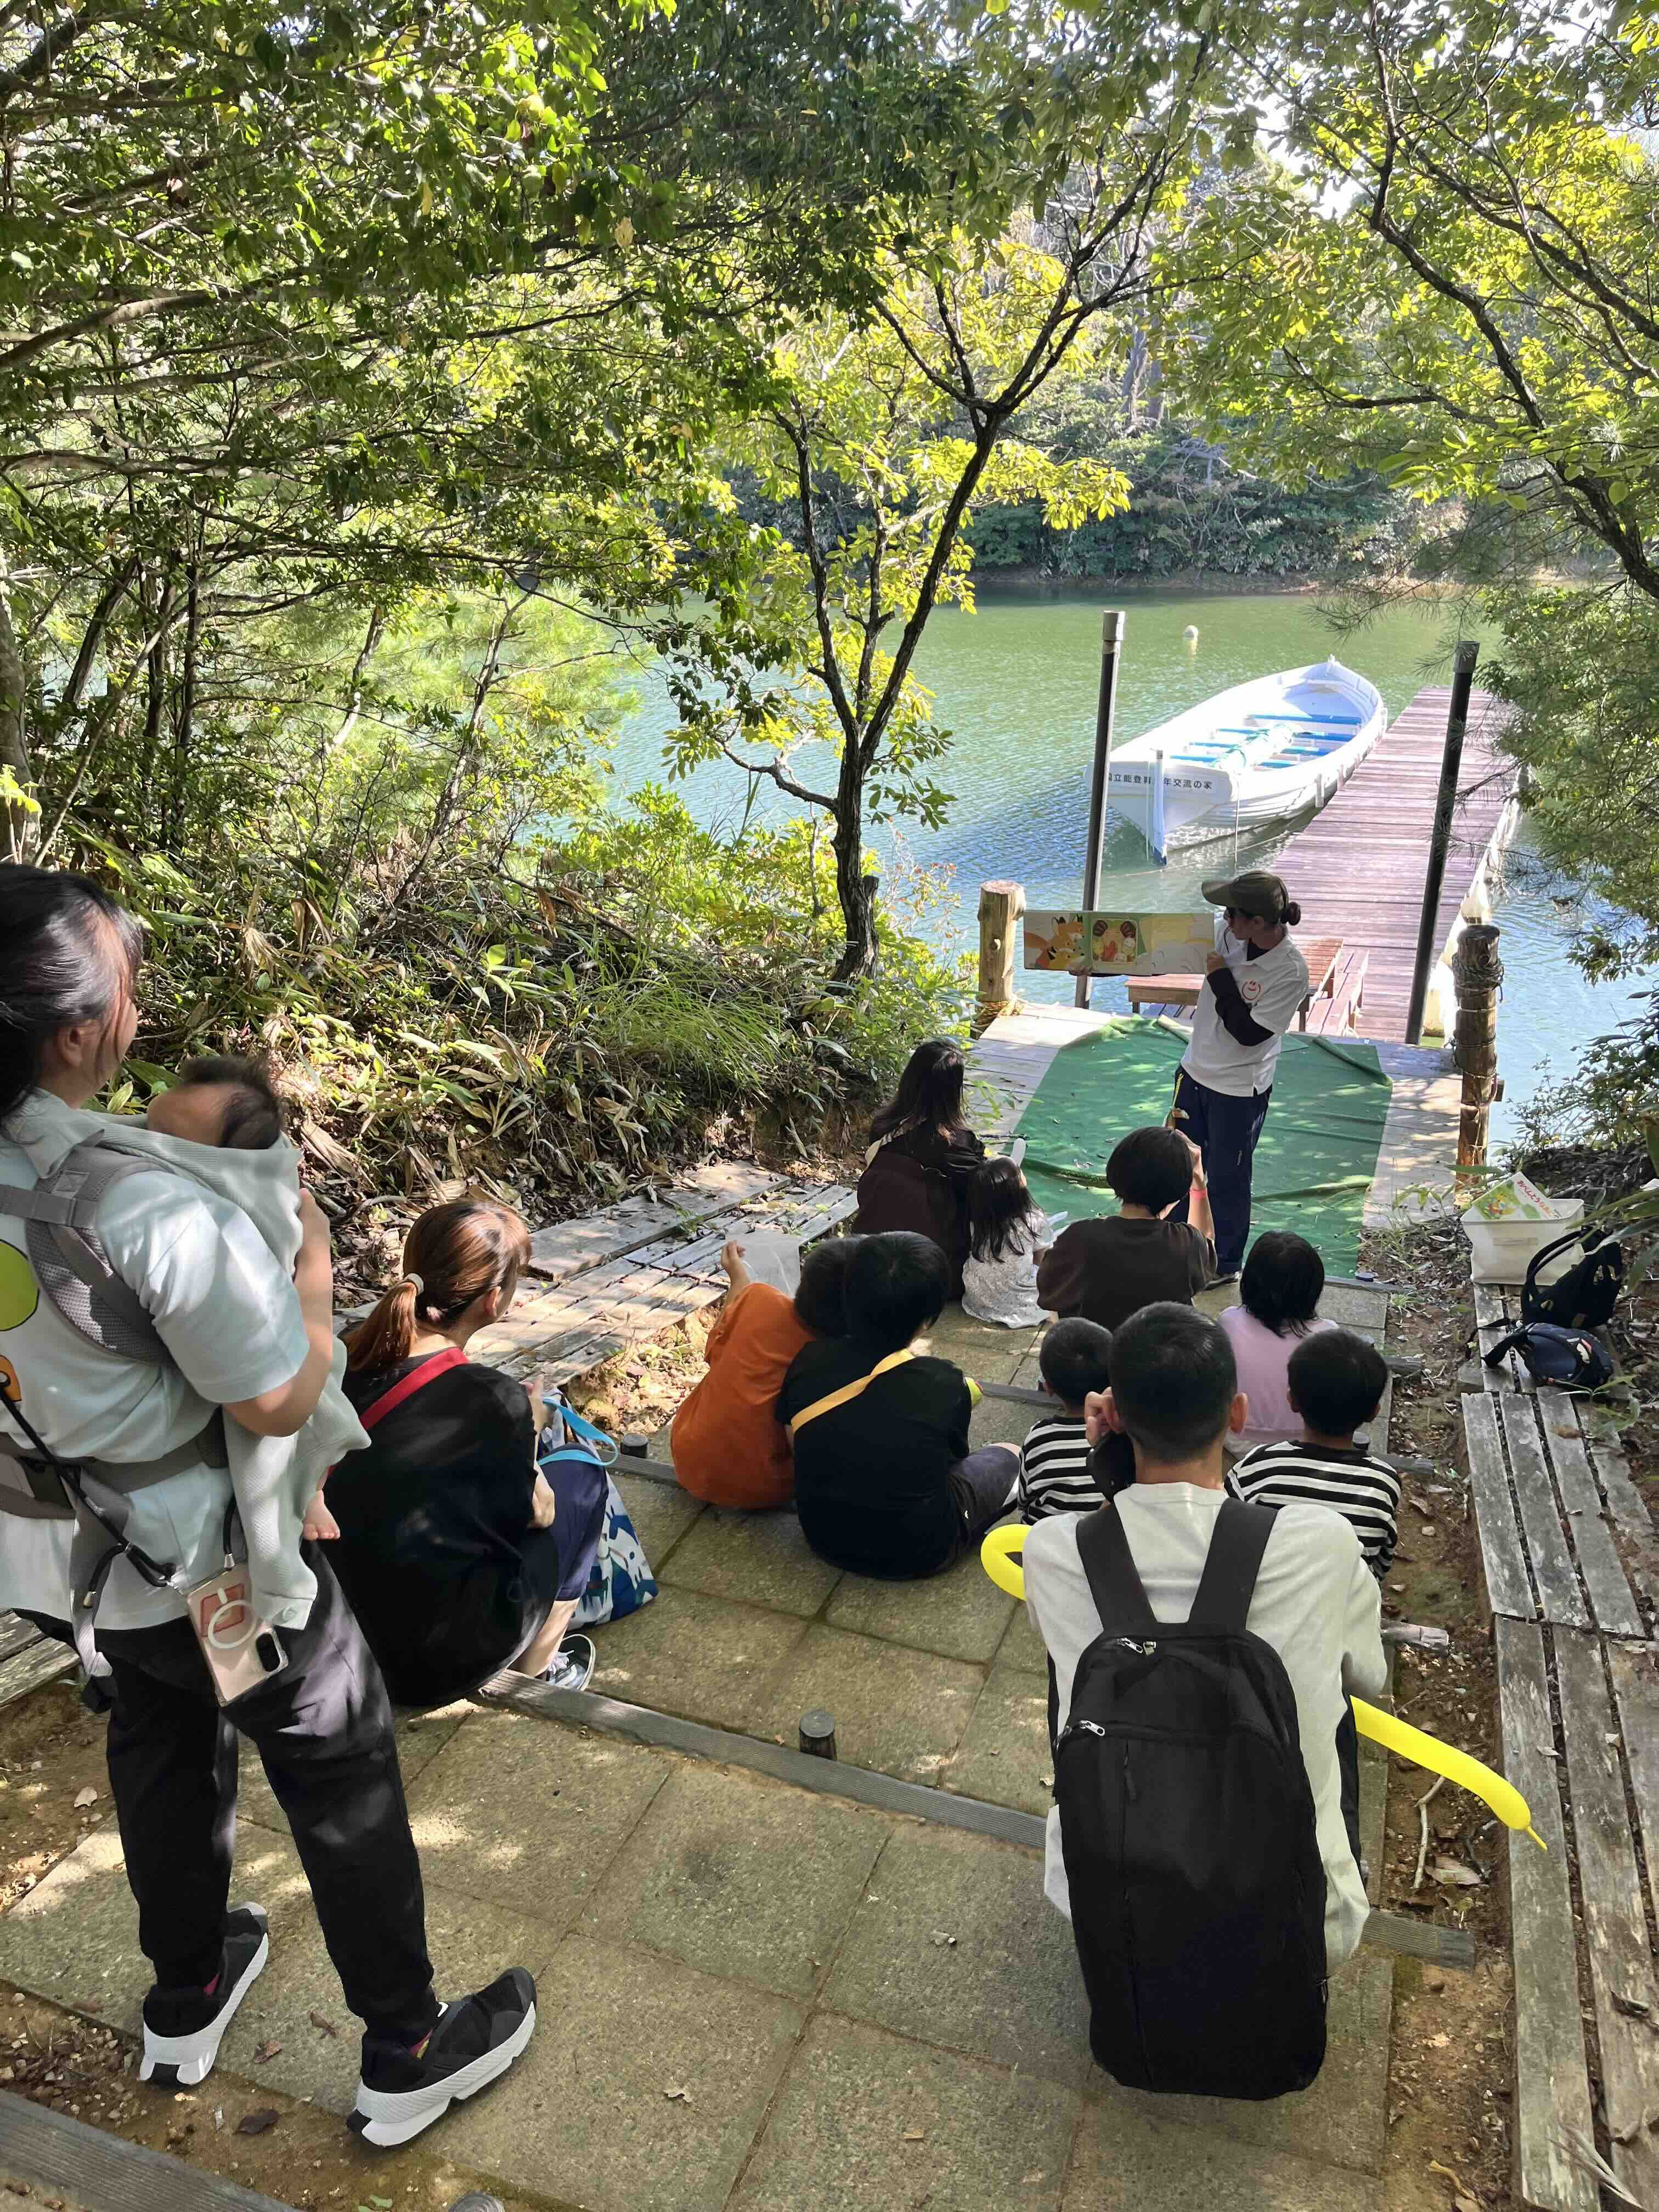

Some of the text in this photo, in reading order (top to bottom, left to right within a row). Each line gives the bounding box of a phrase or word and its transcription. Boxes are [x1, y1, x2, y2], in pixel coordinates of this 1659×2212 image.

[1108, 772, 1212, 789] 立能登青年交流の家
